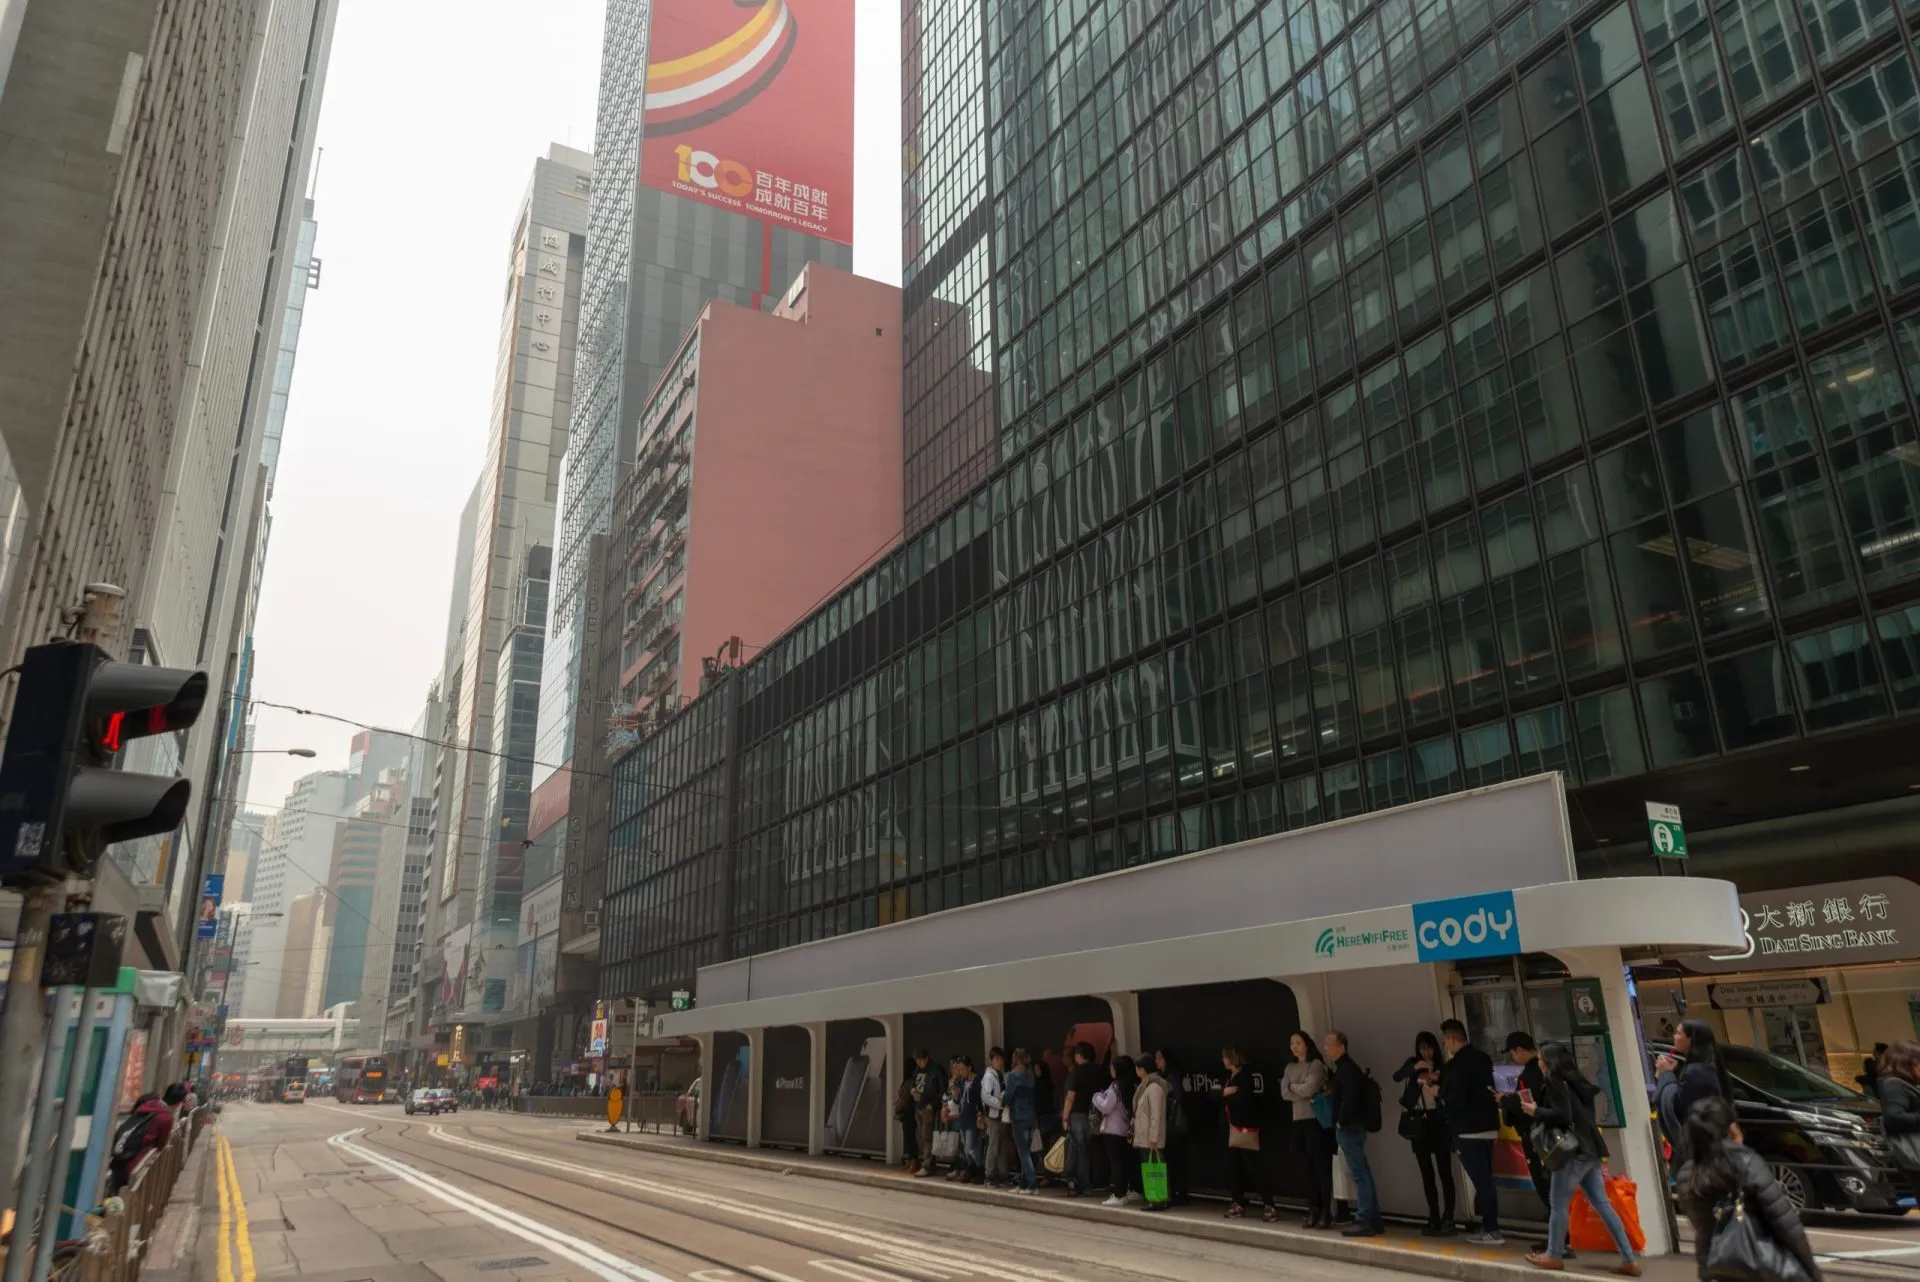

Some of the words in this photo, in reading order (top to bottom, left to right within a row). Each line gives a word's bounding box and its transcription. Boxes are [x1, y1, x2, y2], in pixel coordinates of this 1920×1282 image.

[674, 143, 753, 197] 100
[755, 169, 828, 206] 百年成就
[672, 181, 707, 196] TODAY'S
[707, 190, 742, 208] SUCCESS
[745, 202, 797, 224] TOMORROW'S
[798, 219, 828, 232] LEGACY
[755, 188, 828, 222] 成就百年
[532, 235, 560, 352] 協成行中心
[579, 560, 602, 715] SIBERIAN
[1418, 907, 1513, 949] cody
[1753, 893, 1890, 932] 大新銀行
[1759, 936, 1799, 955] DAH
[1799, 933, 1843, 952] SING
[1842, 929, 1898, 949] BANK
